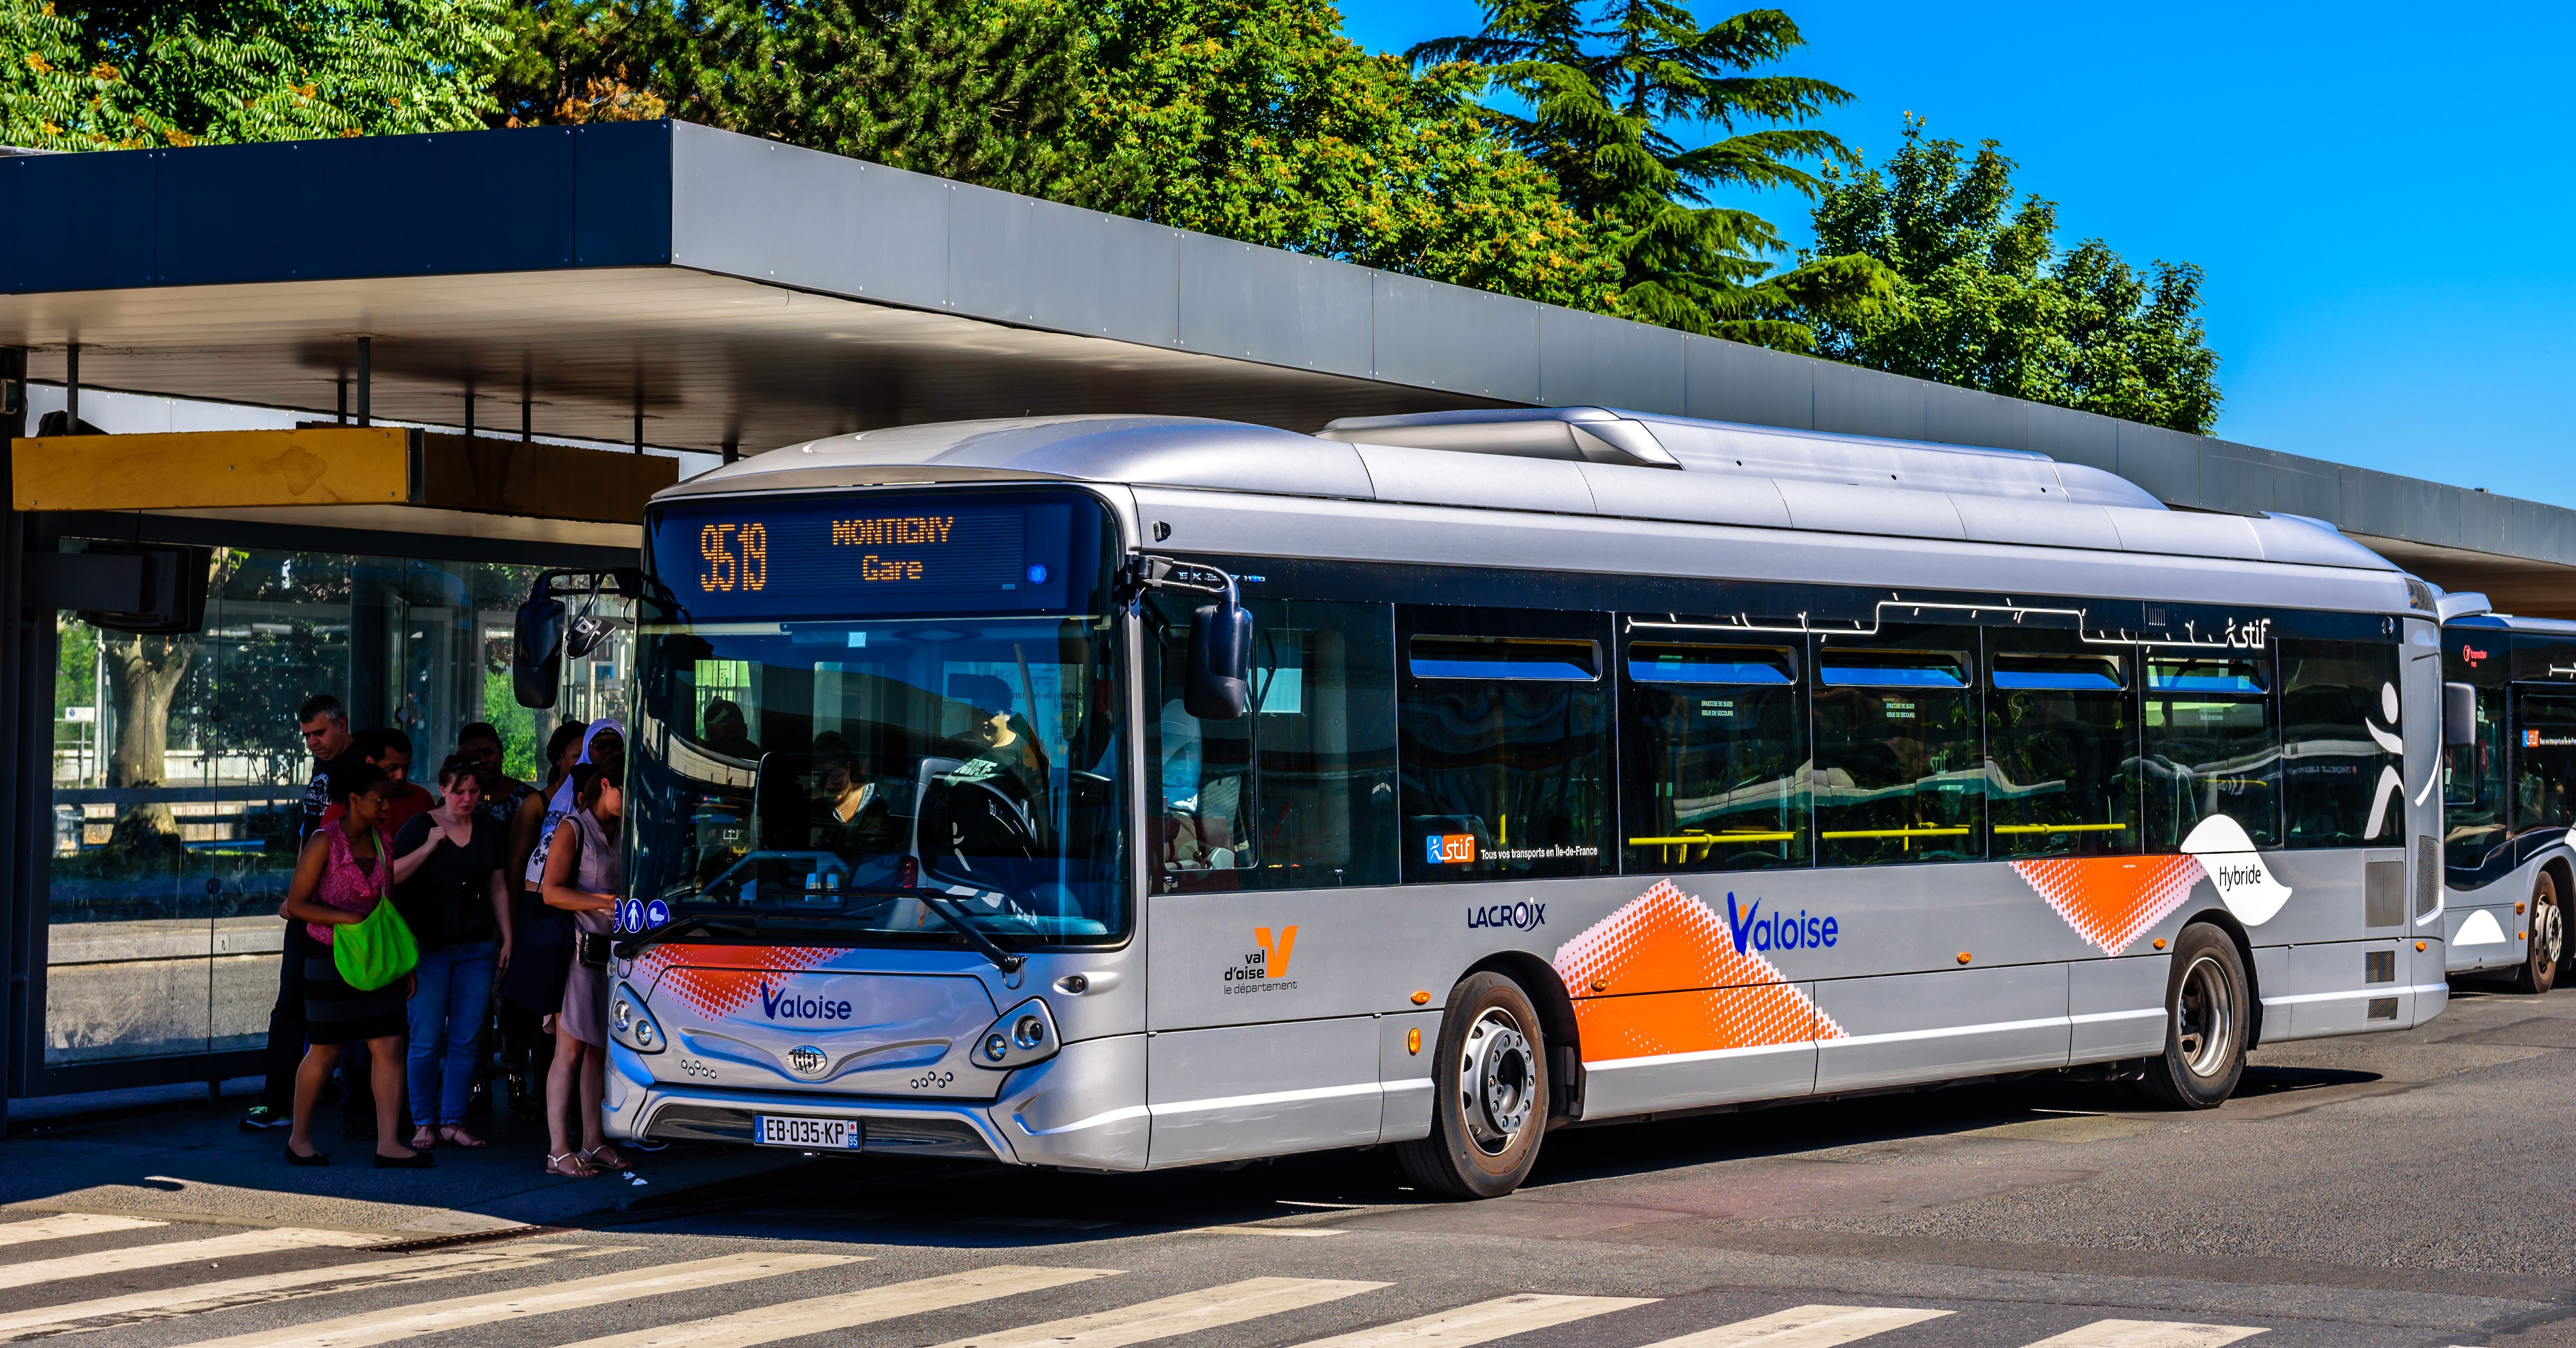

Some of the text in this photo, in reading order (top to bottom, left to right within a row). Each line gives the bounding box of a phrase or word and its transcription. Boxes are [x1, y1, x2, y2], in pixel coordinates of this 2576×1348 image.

[832, 517, 953, 546] MONTIGNY
[700, 522, 767, 592] 9519
[862, 555, 923, 581] Gare
[2242, 618, 2271, 649] stif
[2471, 650, 2487, 659] transdev
[2529, 730, 2539, 745] stif
[954, 758, 998, 777] NIKE
[1446, 836, 1474, 860] stif
[1481, 849, 1497, 860] Tous
[1498, 850, 1510, 859] vos
[1512, 848, 1545, 860] transports
[1555, 844, 1598, 857] Île-de-France
[2220, 864, 2261, 892] Hybride
[1727, 891, 1838, 956] Valoise
[1245, 949, 1265, 964] val
[1224, 966, 1264, 981] d'oise
[761, 982, 852, 1020] Valoise
[1224, 981, 1297, 995] le département
[766, 1119, 844, 1144] EB-035-KP
[849, 1136, 858, 1146] 95
